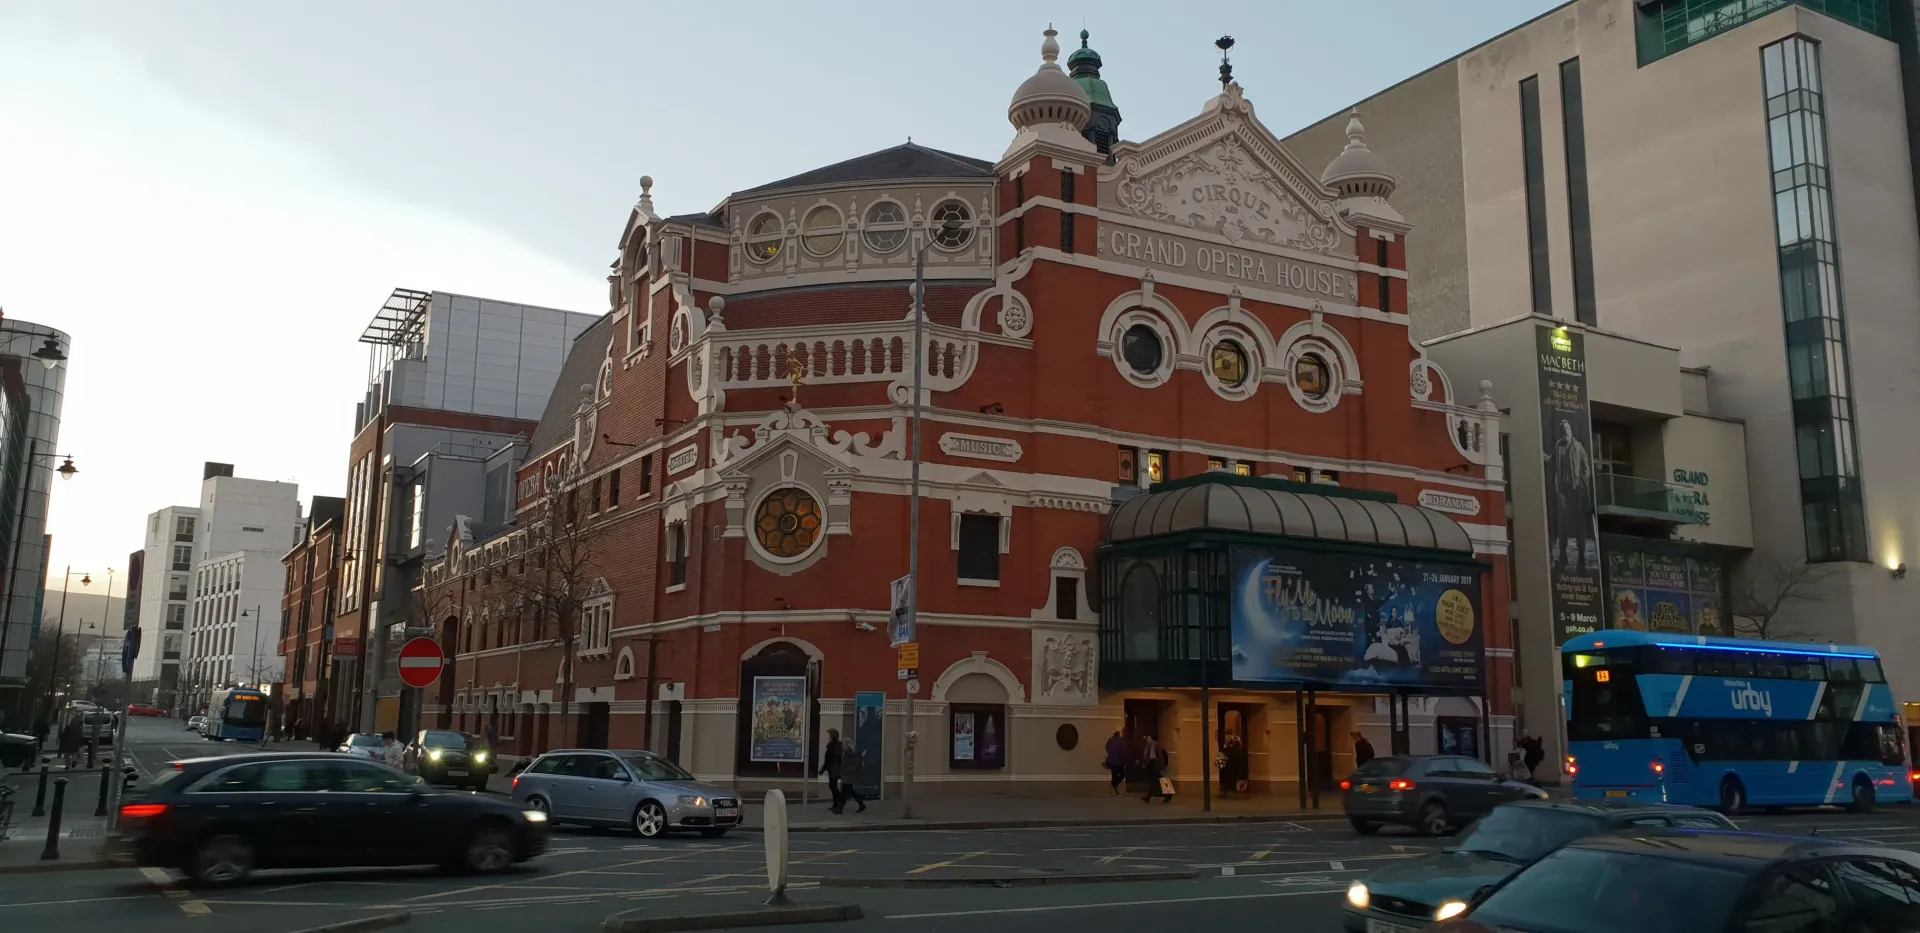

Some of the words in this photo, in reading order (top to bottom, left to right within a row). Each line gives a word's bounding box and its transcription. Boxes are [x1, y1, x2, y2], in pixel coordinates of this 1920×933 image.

[1192, 184, 1271, 219] CIRQUE
[1111, 230, 1187, 267] GRAND
[1196, 247, 1268, 284] OPERA
[1276, 262, 1345, 298] HOUSE
[1541, 354, 1584, 372] MACBETH
[960, 440, 1001, 455] MUSIC
[1673, 468, 1708, 486] GRAND
[1432, 495, 1465, 509] DRAMA
[1560, 612, 1566, 621] 5
[1570, 613, 1576, 621] 9
[1576, 613, 1598, 623] March
[1565, 625, 1595, 634] goh.co.uk
[1731, 681, 1773, 717] urby
